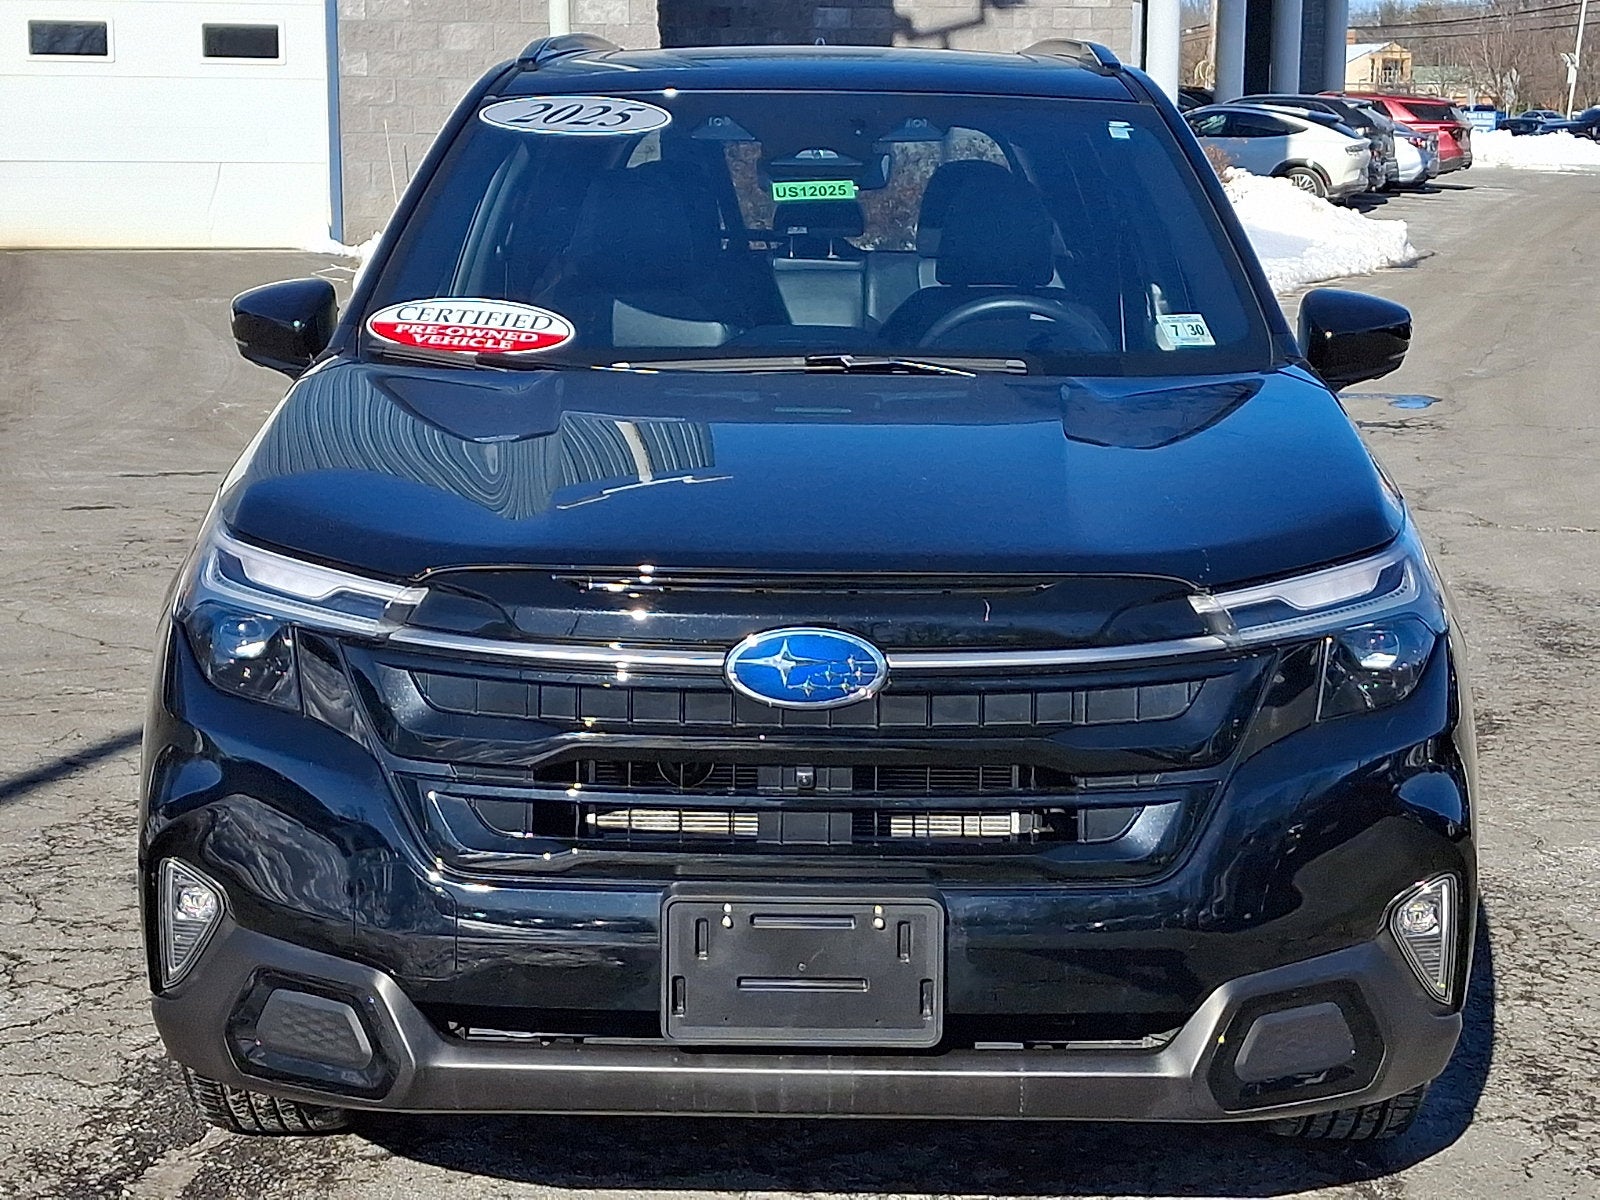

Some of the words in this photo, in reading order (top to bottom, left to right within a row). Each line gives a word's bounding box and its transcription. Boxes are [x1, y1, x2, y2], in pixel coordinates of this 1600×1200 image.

[507, 103, 646, 126] 2025
[775, 184, 847, 198] US12025
[396, 305, 554, 330] CERTIFIED
[394, 323, 539, 342] PRE-OWNED
[1169, 324, 1179, 337] 7
[1187, 324, 1205, 336] 30
[412, 333, 515, 350] VEHICLE
